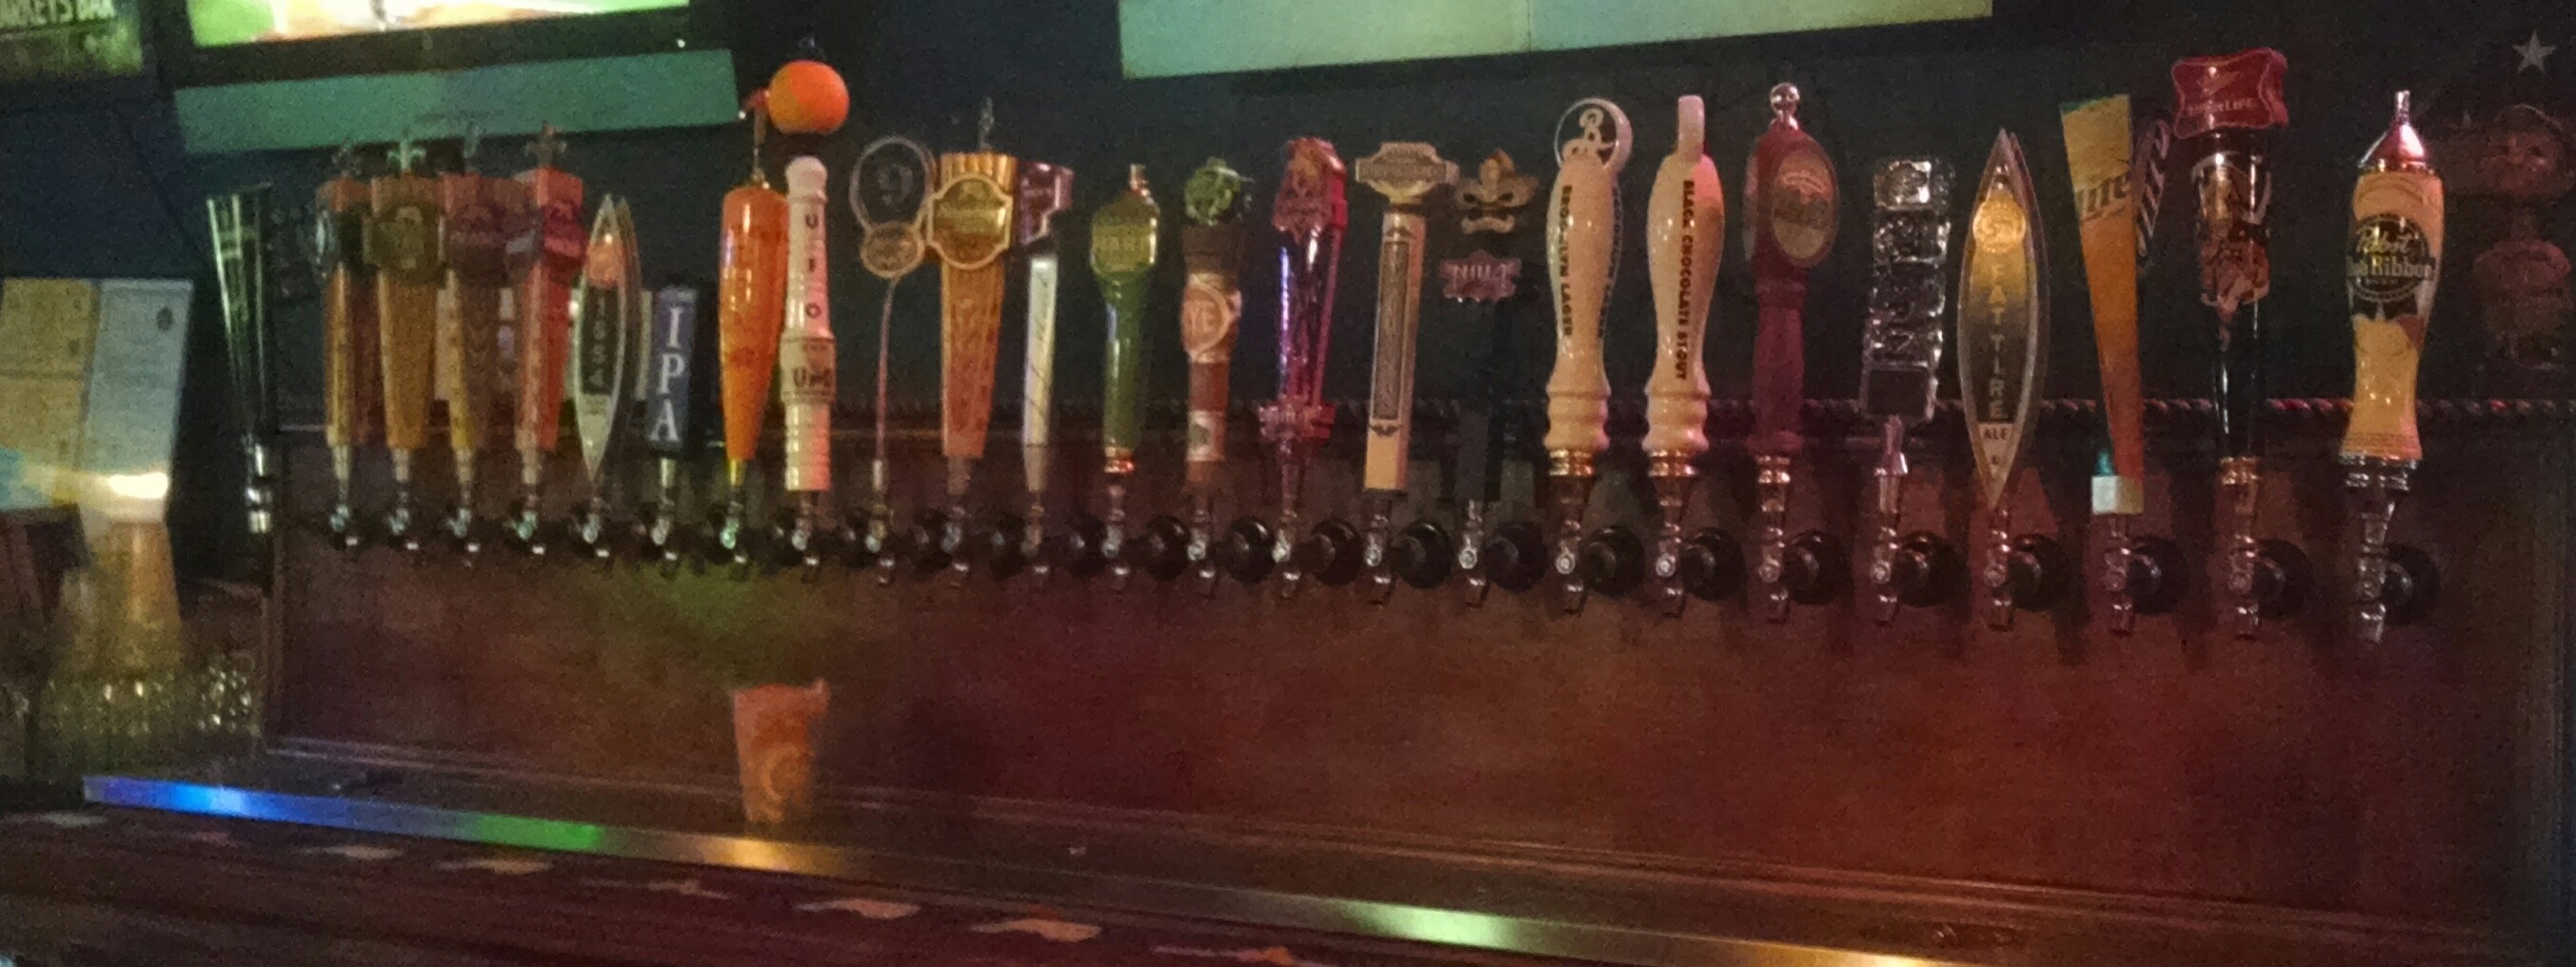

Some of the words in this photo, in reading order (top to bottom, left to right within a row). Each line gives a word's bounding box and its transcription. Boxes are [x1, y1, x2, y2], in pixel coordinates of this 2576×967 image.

[1683, 180, 1695, 228] BLACK
[2356, 225, 2413, 254] Pabst
[1678, 235, 1694, 326] CHOCOLATE
[1989, 265, 2009, 325] FAT
[1561, 283, 1573, 337] LAGER
[649, 306, 685, 442] IPA
[1675, 331, 1689, 380] STOUT
[1988, 333, 2006, 420] TIRE
[1983, 427, 2008, 441] ALE
